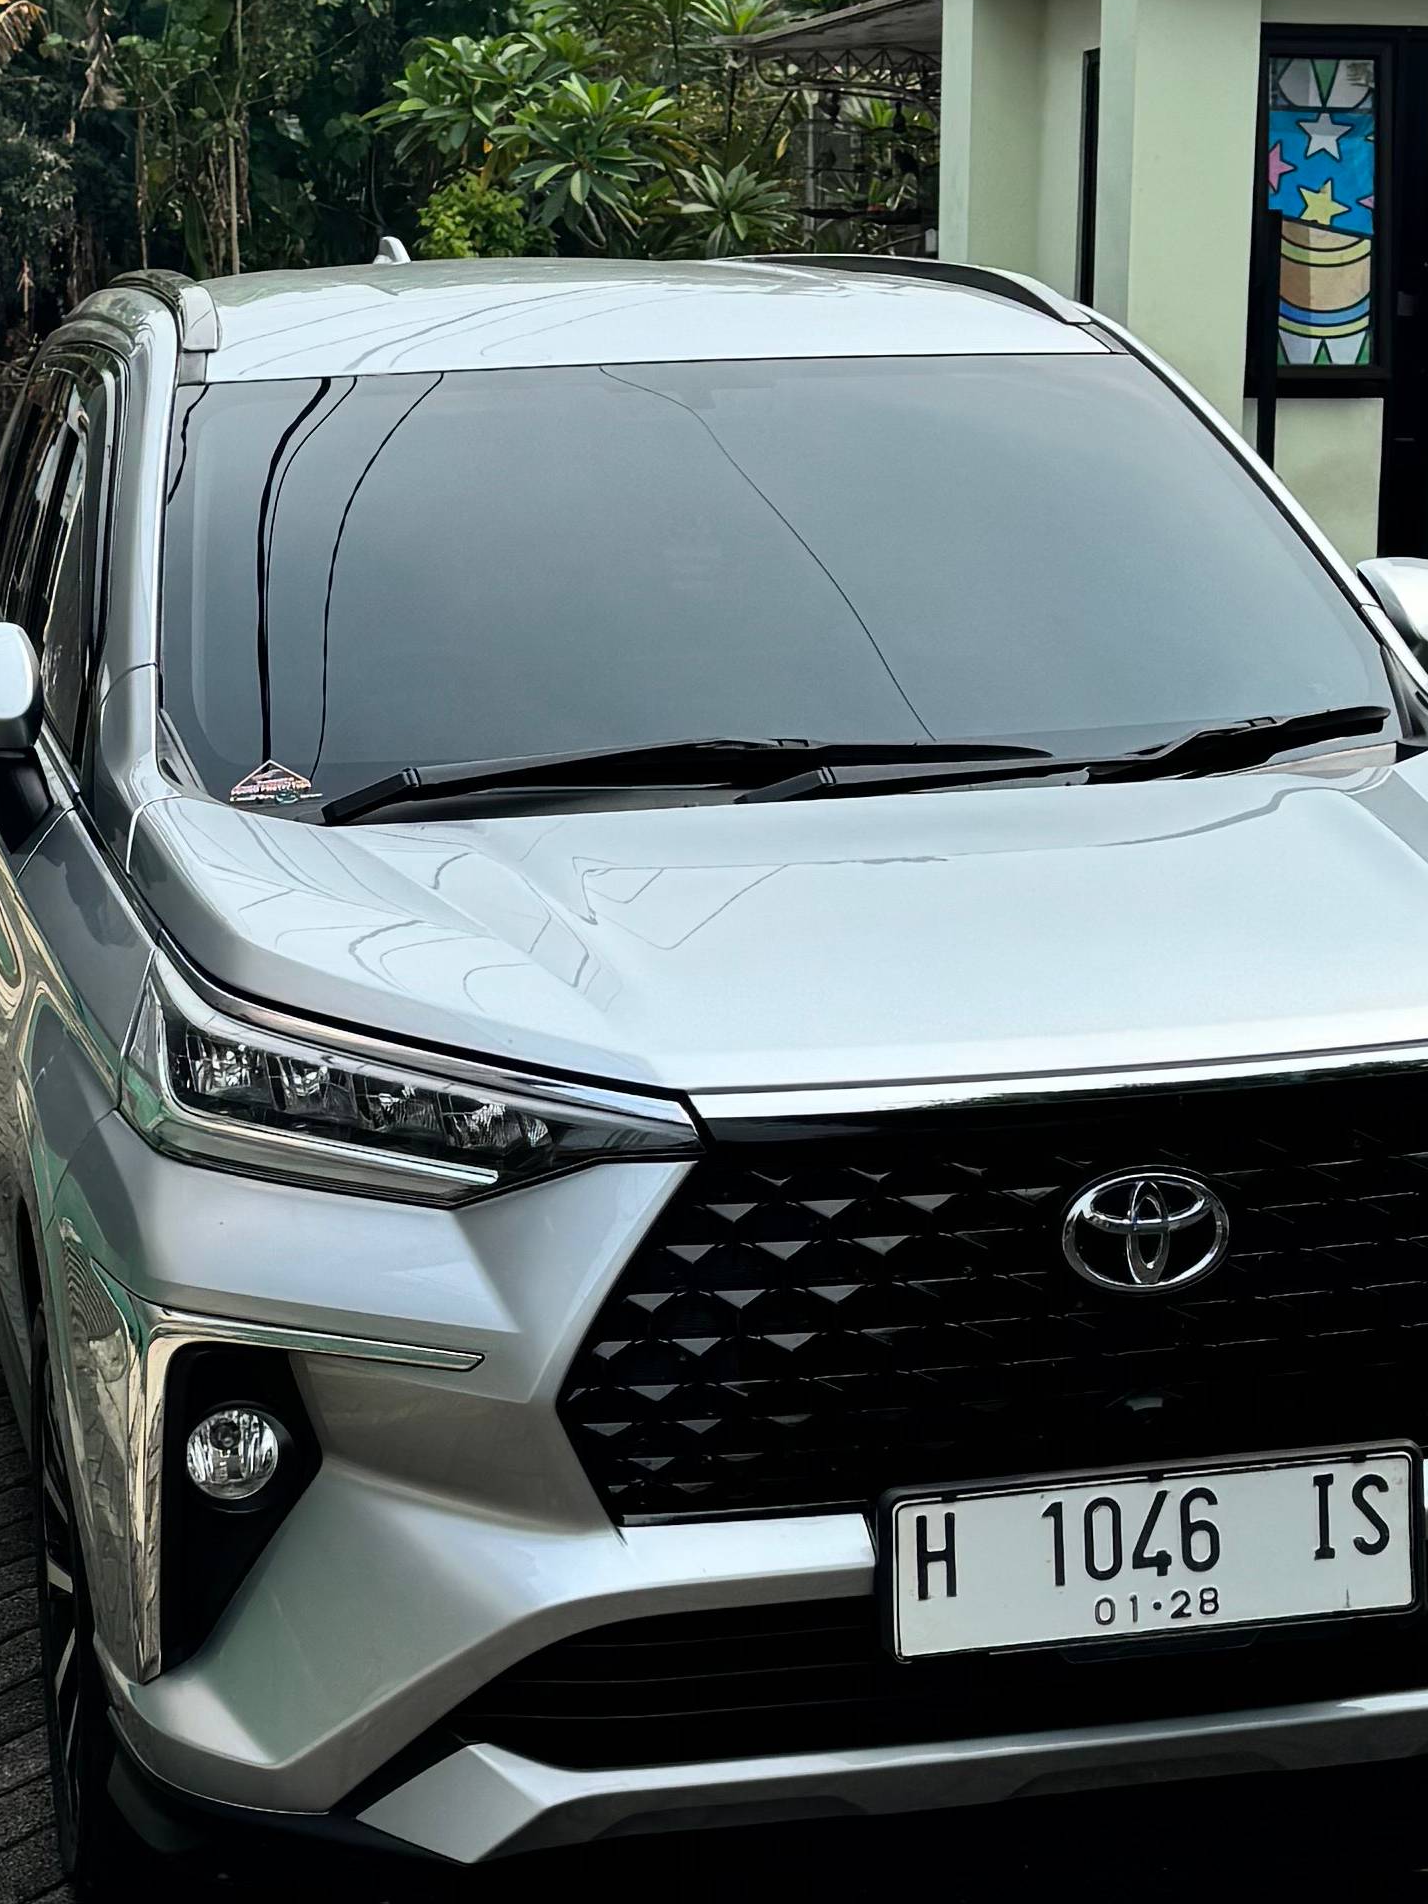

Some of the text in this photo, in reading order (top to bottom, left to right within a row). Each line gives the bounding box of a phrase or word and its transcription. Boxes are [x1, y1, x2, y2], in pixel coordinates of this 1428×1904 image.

[915, 1472, 1390, 1601] H 1046 IS
